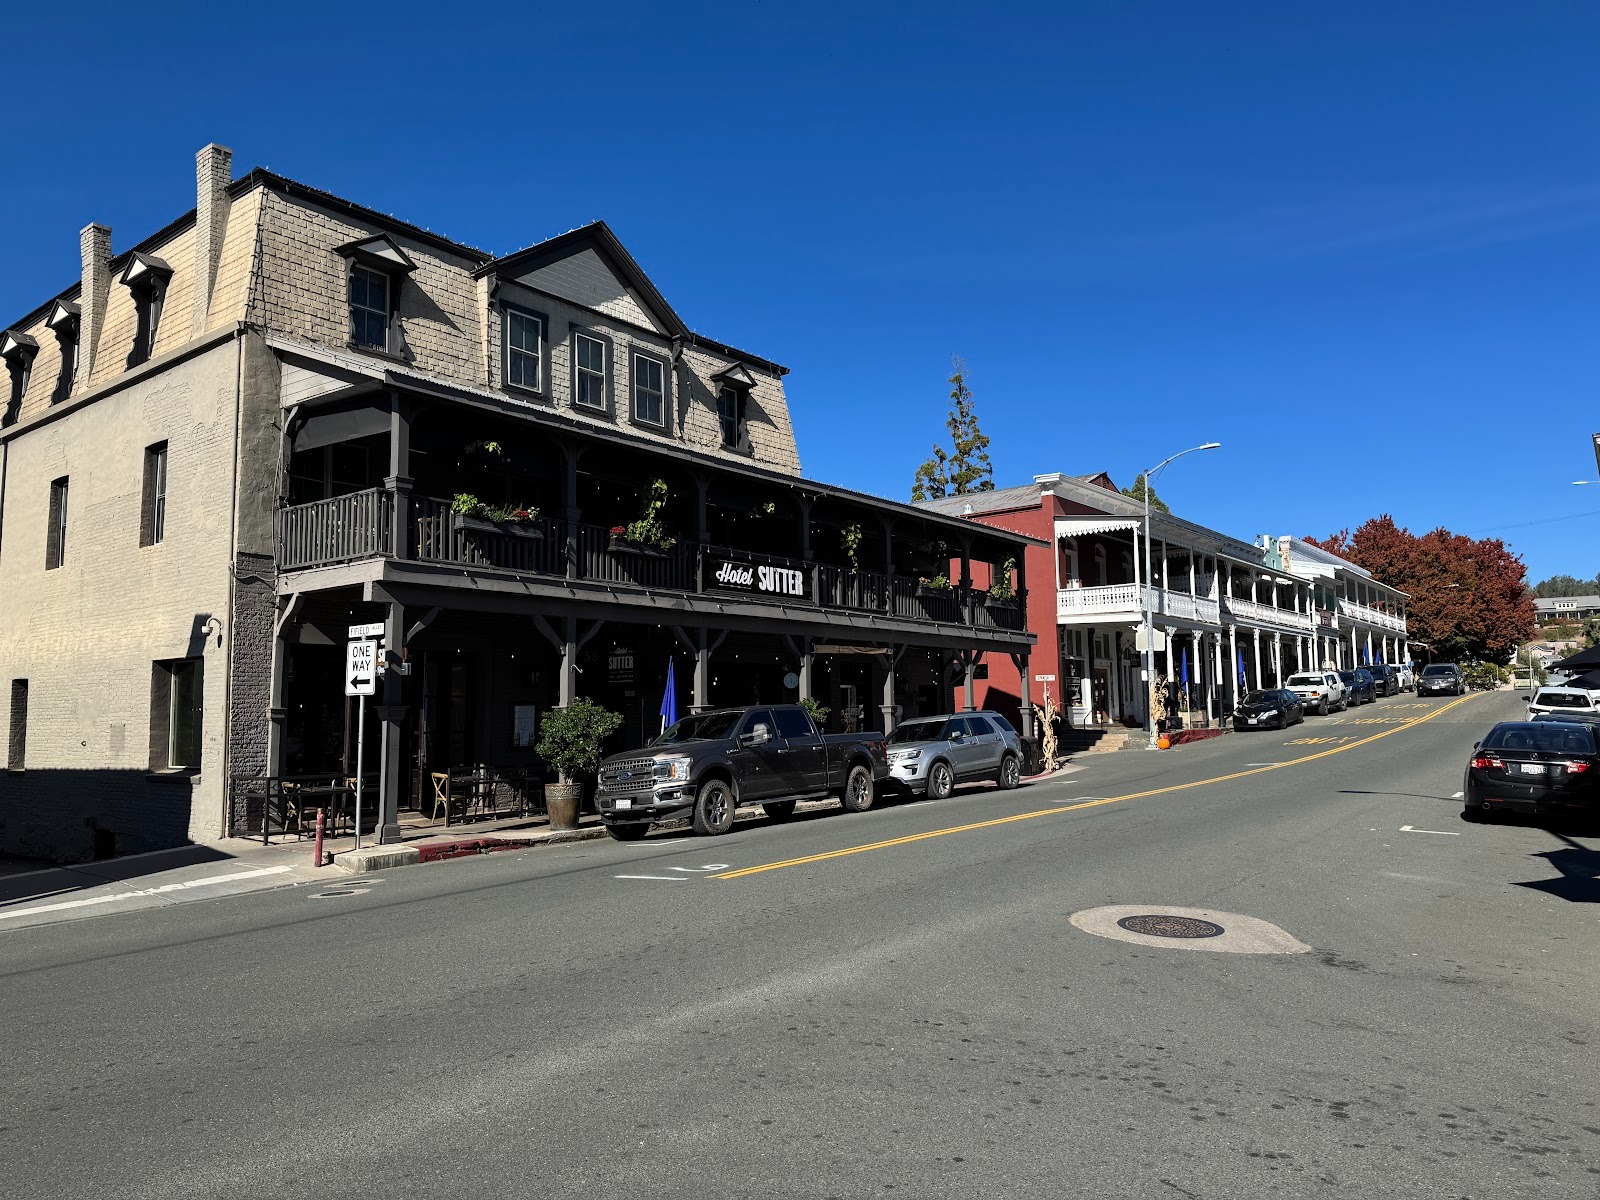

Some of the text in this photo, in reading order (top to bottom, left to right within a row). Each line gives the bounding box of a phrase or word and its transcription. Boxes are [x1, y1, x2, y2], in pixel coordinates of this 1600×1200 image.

[715, 562, 804, 596] Hotel SUTTER
[350, 626, 369, 636] FIFIELD
[352, 646, 371, 658] ONE
[352, 660, 371, 672] WAY
[608, 656, 634, 670] SUTTER
